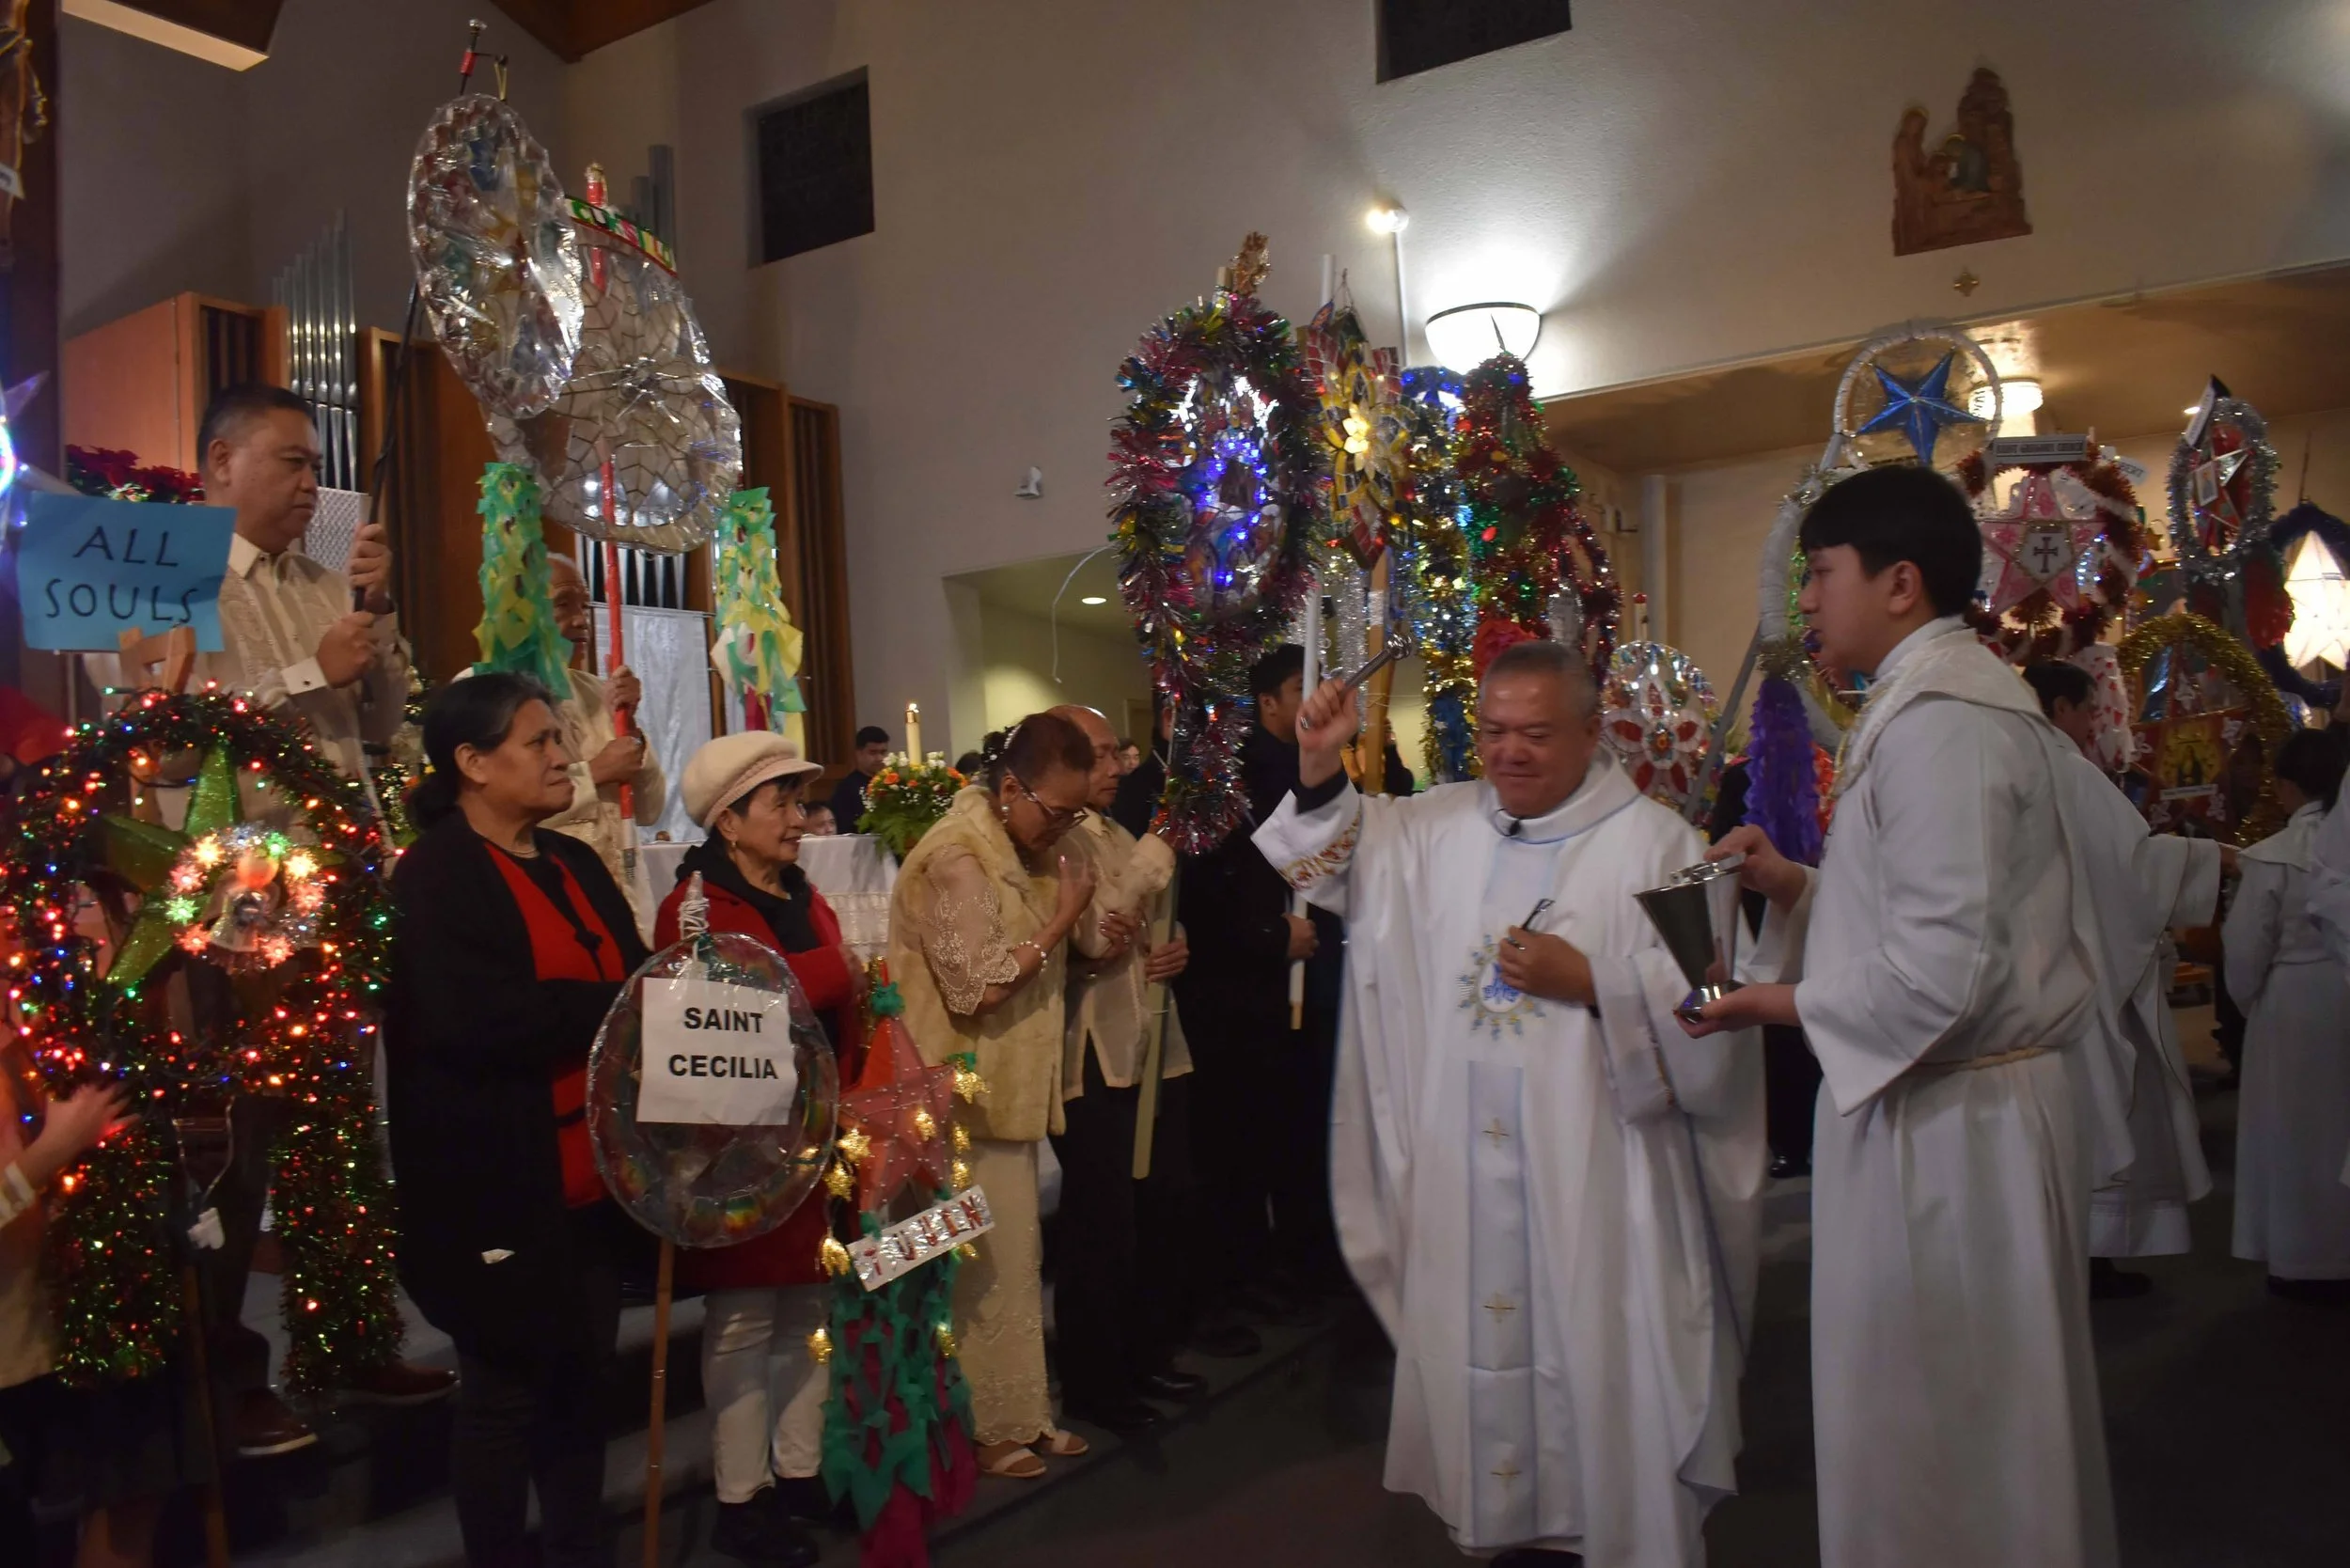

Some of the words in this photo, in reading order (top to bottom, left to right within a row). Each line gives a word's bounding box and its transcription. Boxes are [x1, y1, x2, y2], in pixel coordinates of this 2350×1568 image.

[72, 525, 179, 567] ALL
[45, 578, 199, 624] SOULS
[683, 1007, 763, 1033] SAINT
[668, 1054, 779, 1079] CECILIA
